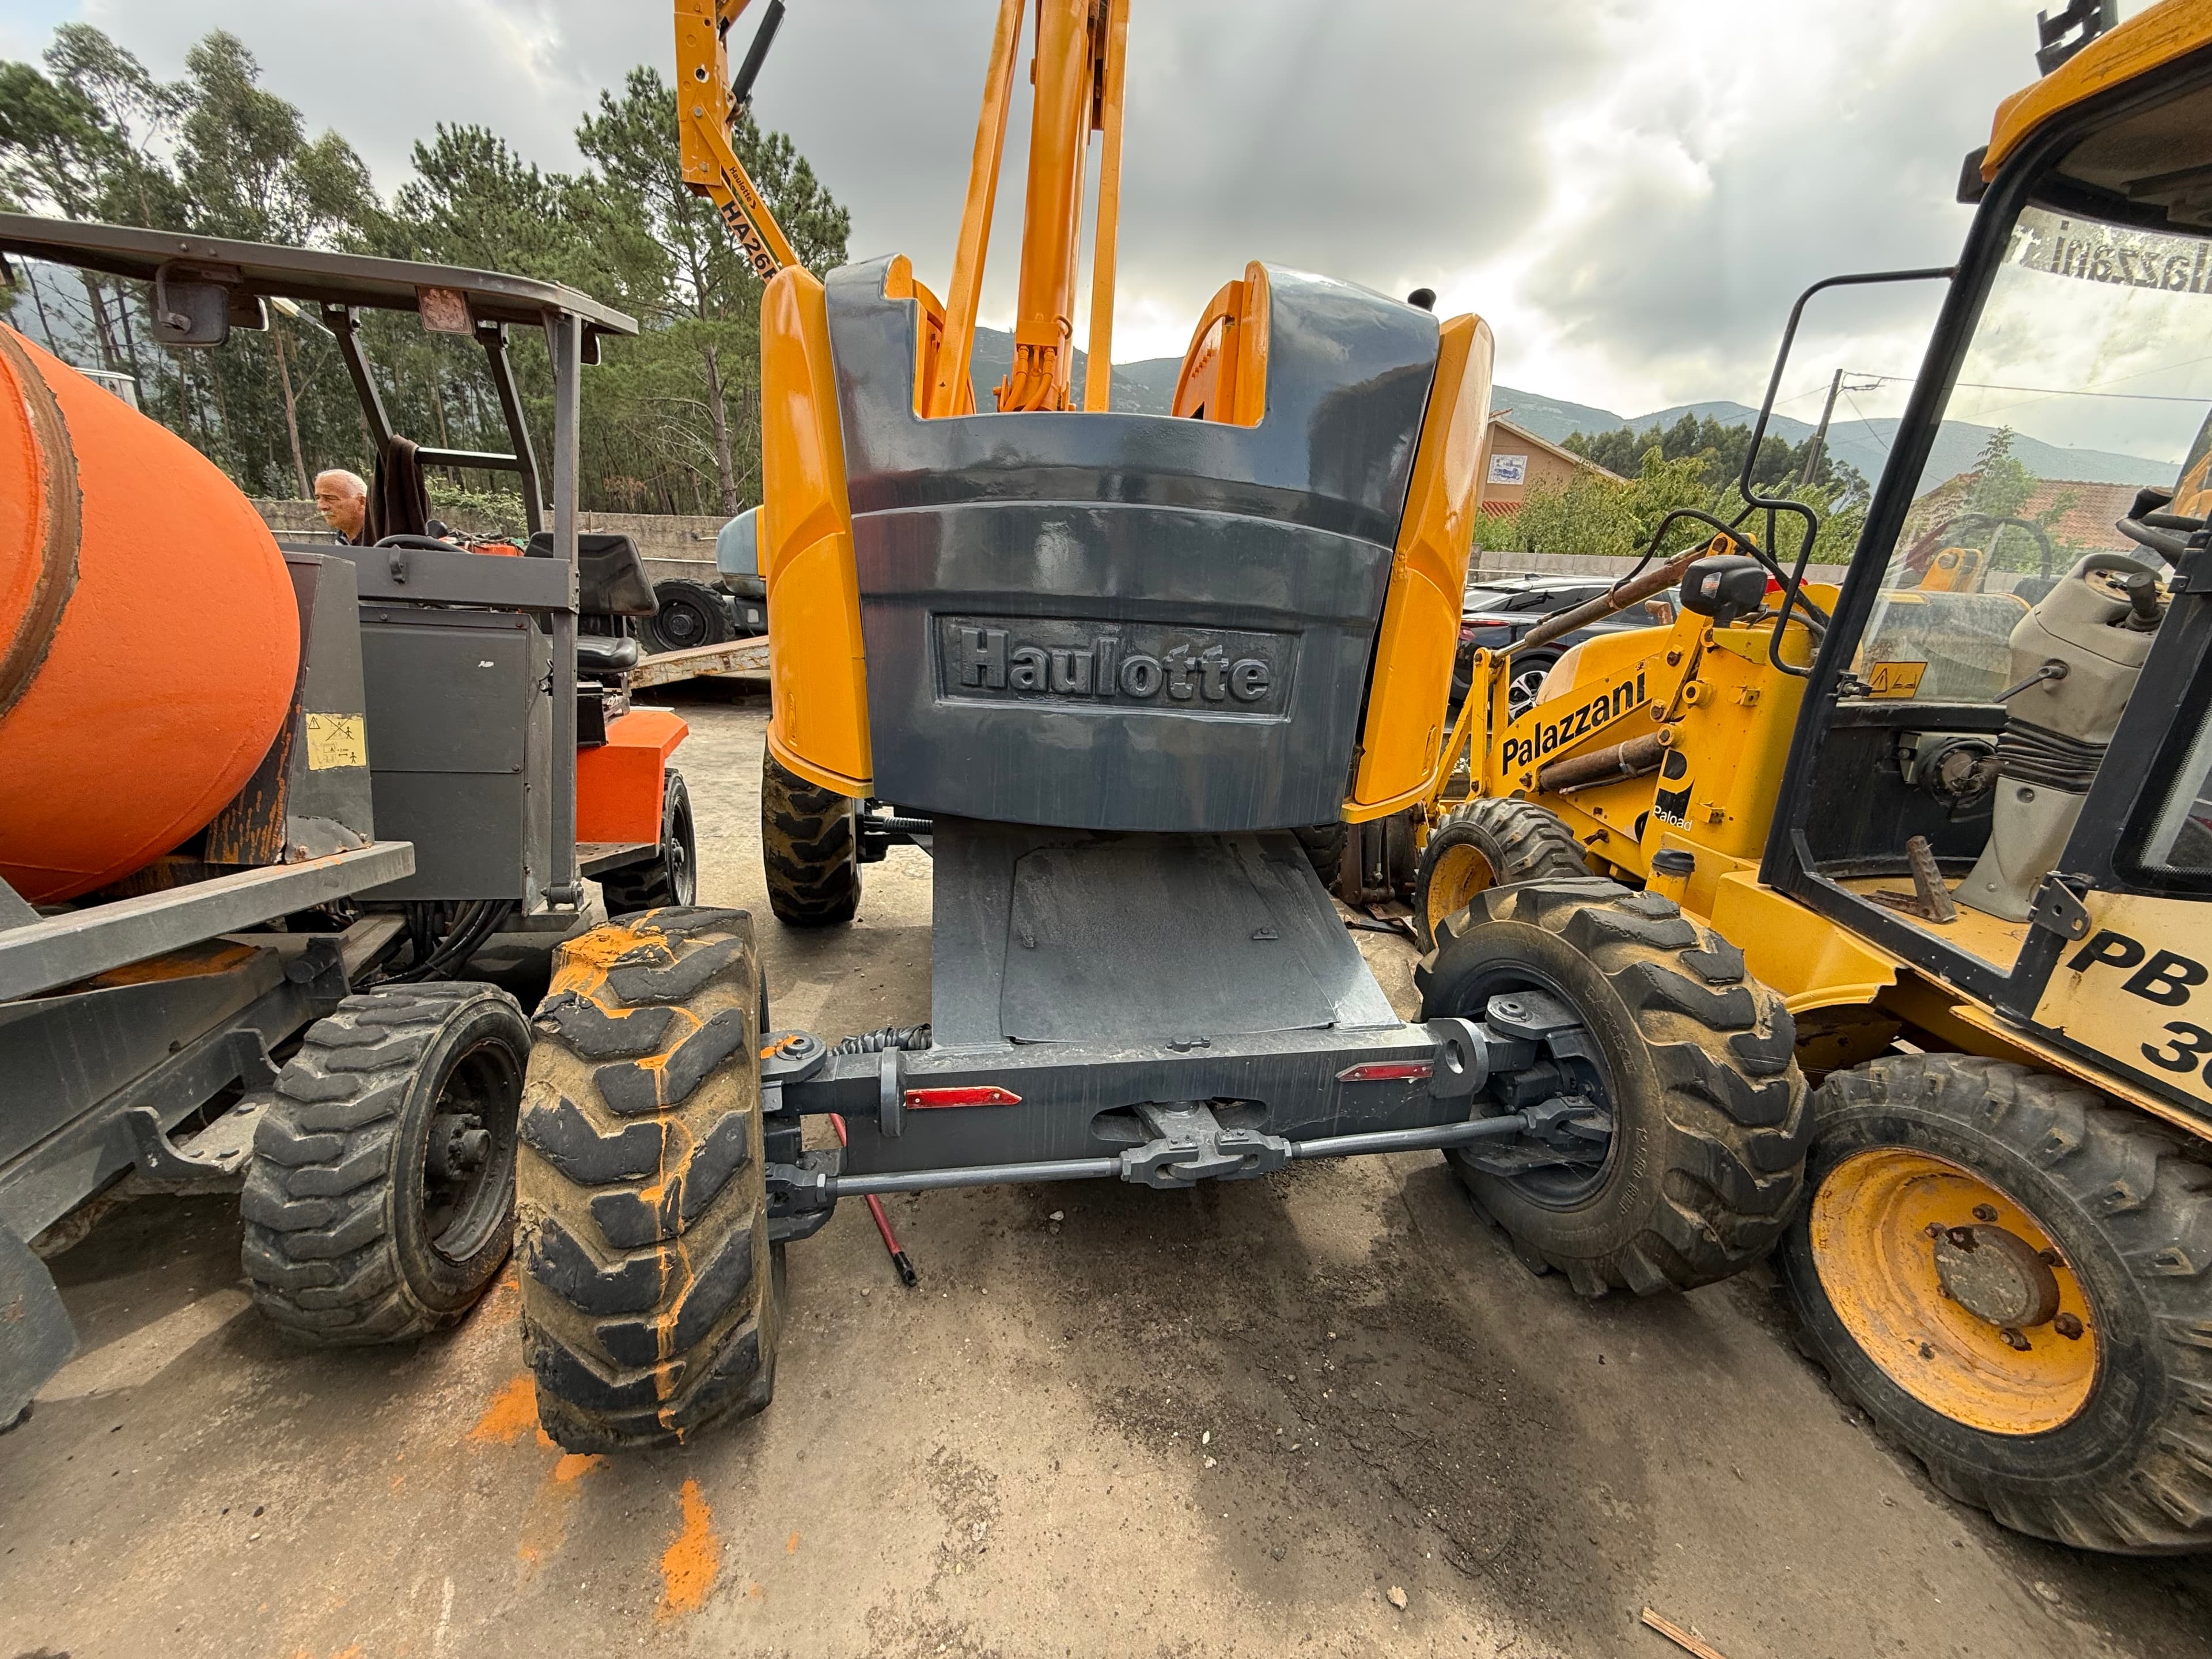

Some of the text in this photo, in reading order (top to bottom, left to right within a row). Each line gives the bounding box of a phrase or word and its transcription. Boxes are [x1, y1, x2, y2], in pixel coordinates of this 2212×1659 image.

[729, 166, 751, 203] Haulotte
[960, 628, 1270, 702] Haulotte
[1502, 672, 1646, 777] Palazzani
[1652, 805, 1693, 832] Paload
[2066, 929, 2209, 1007] PB
